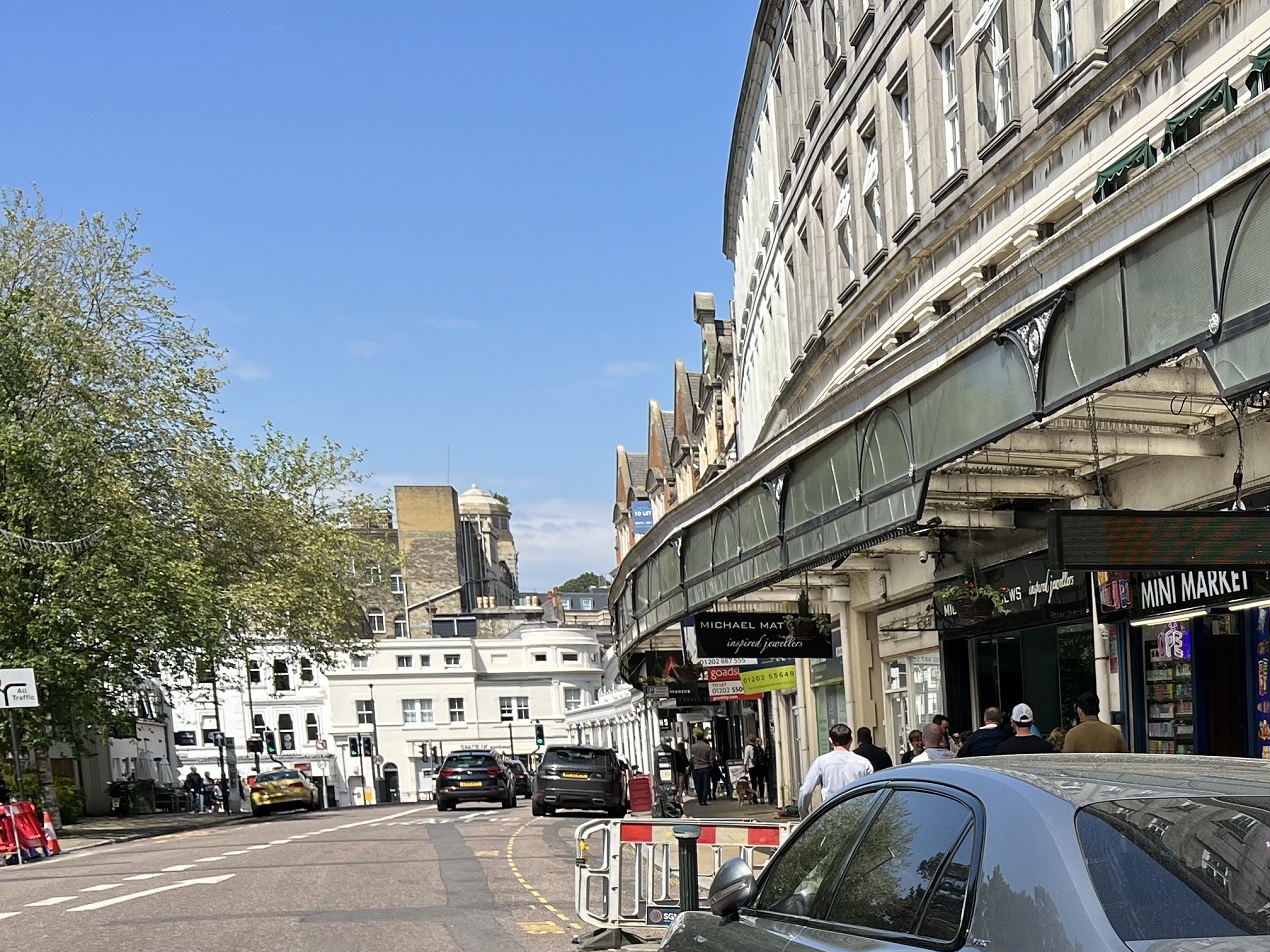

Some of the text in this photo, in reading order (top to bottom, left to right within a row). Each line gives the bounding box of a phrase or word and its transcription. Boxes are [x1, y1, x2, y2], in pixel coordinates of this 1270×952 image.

[1141, 570, 1248, 610] MINI MARKET
[700, 621, 785, 630] MICHAEL MAT
[727, 634, 804, 654] inspired jewellers
[700, 658, 720, 666] 01202
[743, 675, 765, 684] 01202
